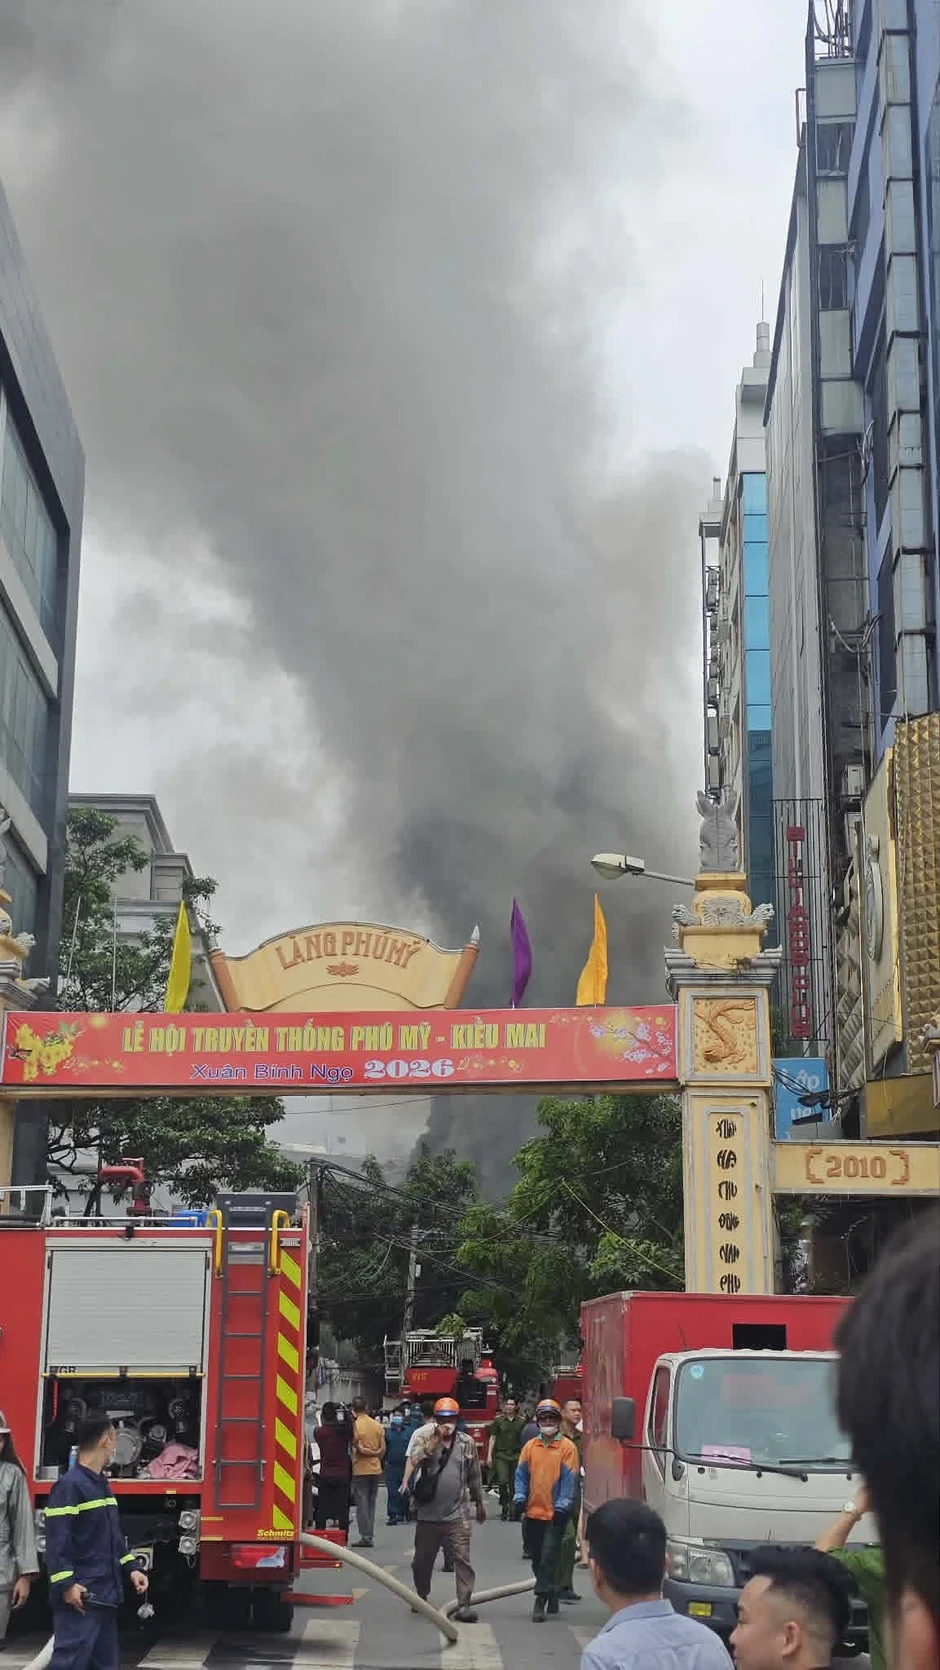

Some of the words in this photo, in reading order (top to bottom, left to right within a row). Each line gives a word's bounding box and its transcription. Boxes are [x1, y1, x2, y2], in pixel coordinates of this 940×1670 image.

[275, 932, 337, 970] LÀNG
[122, 1020, 144, 1052] LỄ
[150, 1023, 186, 1056] HỘI
[192, 1018, 270, 1052] TRUYỀN
[276, 1018, 345, 1052] THỐNG
[351, 1021, 394, 1051] PHÚ
[399, 1021, 432, 1050] MỸ
[450, 1016, 500, 1050] KIỀU
[504, 1023, 547, 1049] MAI
[190, 1063, 247, 1080] Xuân
[254, 1063, 304, 1080] Bính
[309, 1062, 354, 1083] Ngọ
[363, 1058, 455, 1079] 2026
[826, 1155, 887, 1178] 2010
